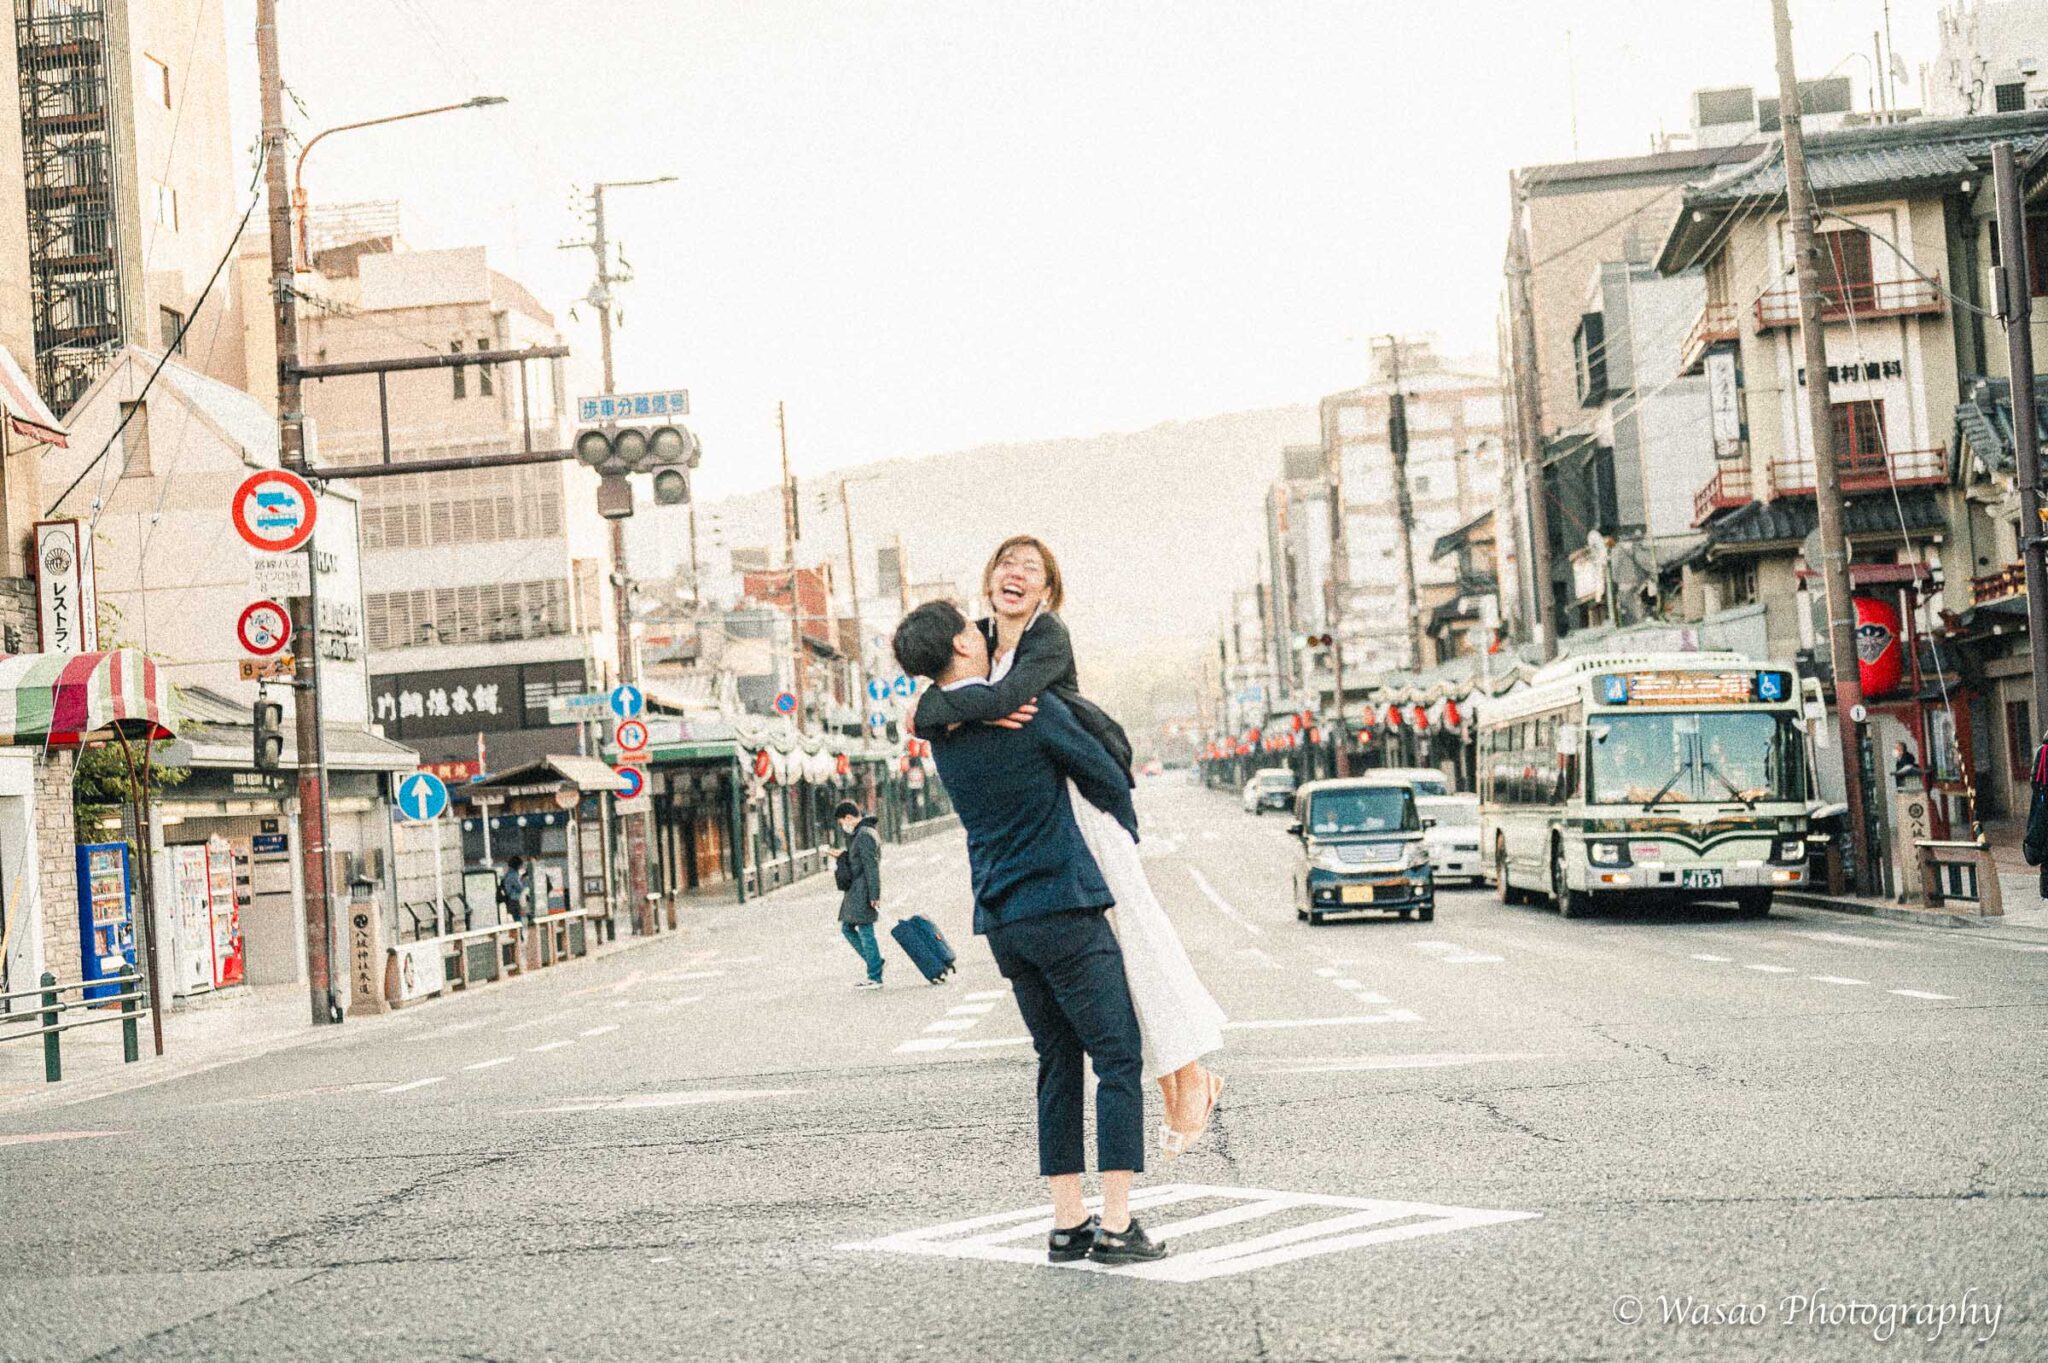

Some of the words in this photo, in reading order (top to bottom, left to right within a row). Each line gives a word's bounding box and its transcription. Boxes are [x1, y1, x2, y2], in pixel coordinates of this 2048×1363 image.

[583, 393, 684, 419] 歩車分離信号
